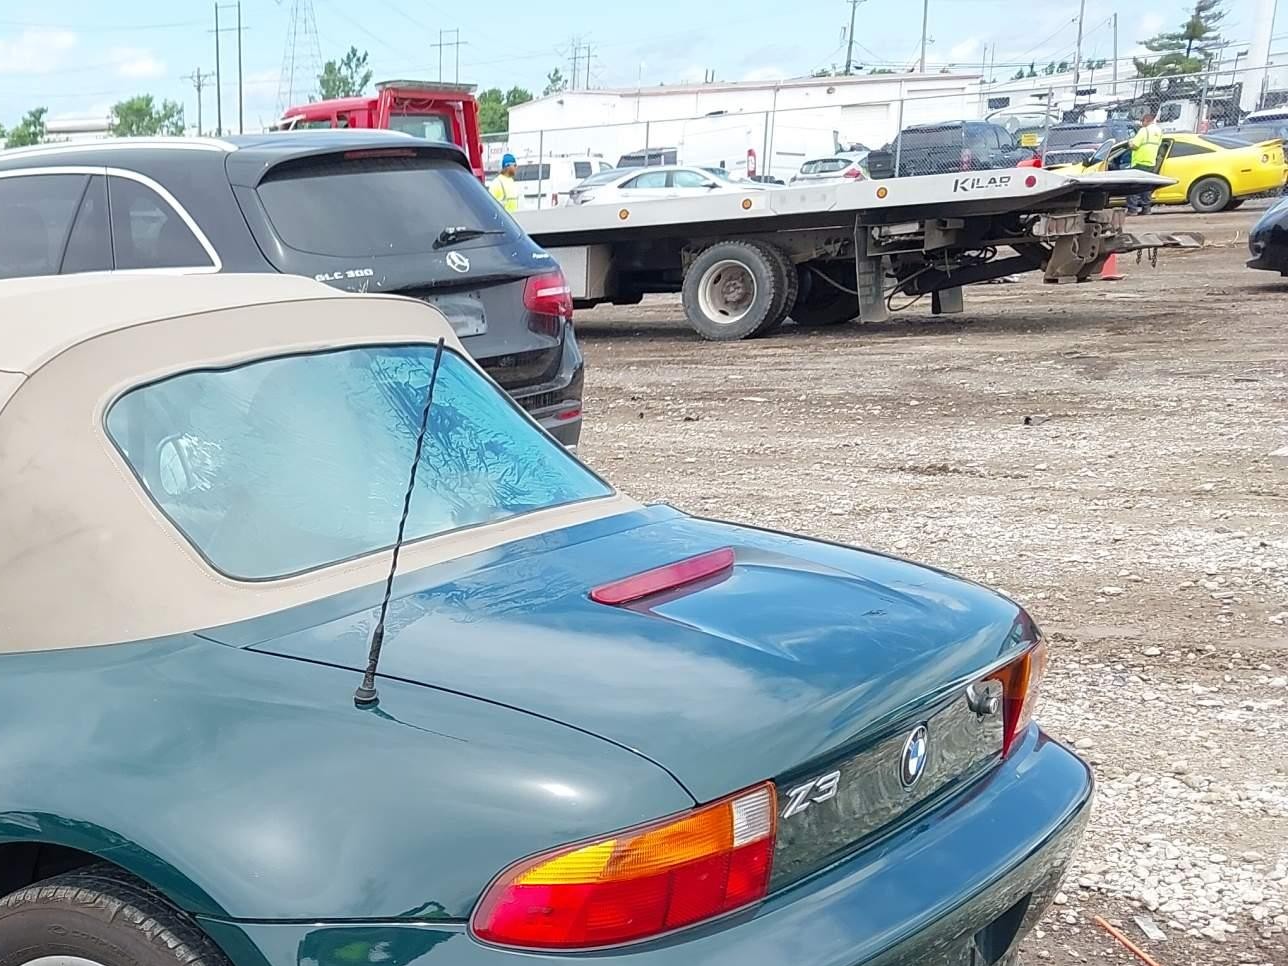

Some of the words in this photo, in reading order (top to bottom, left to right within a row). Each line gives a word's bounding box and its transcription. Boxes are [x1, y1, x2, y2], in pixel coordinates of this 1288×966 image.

[314, 271, 344, 282] GLC
[345, 268, 374, 279] 300
[783, 770, 841, 819] Z3
